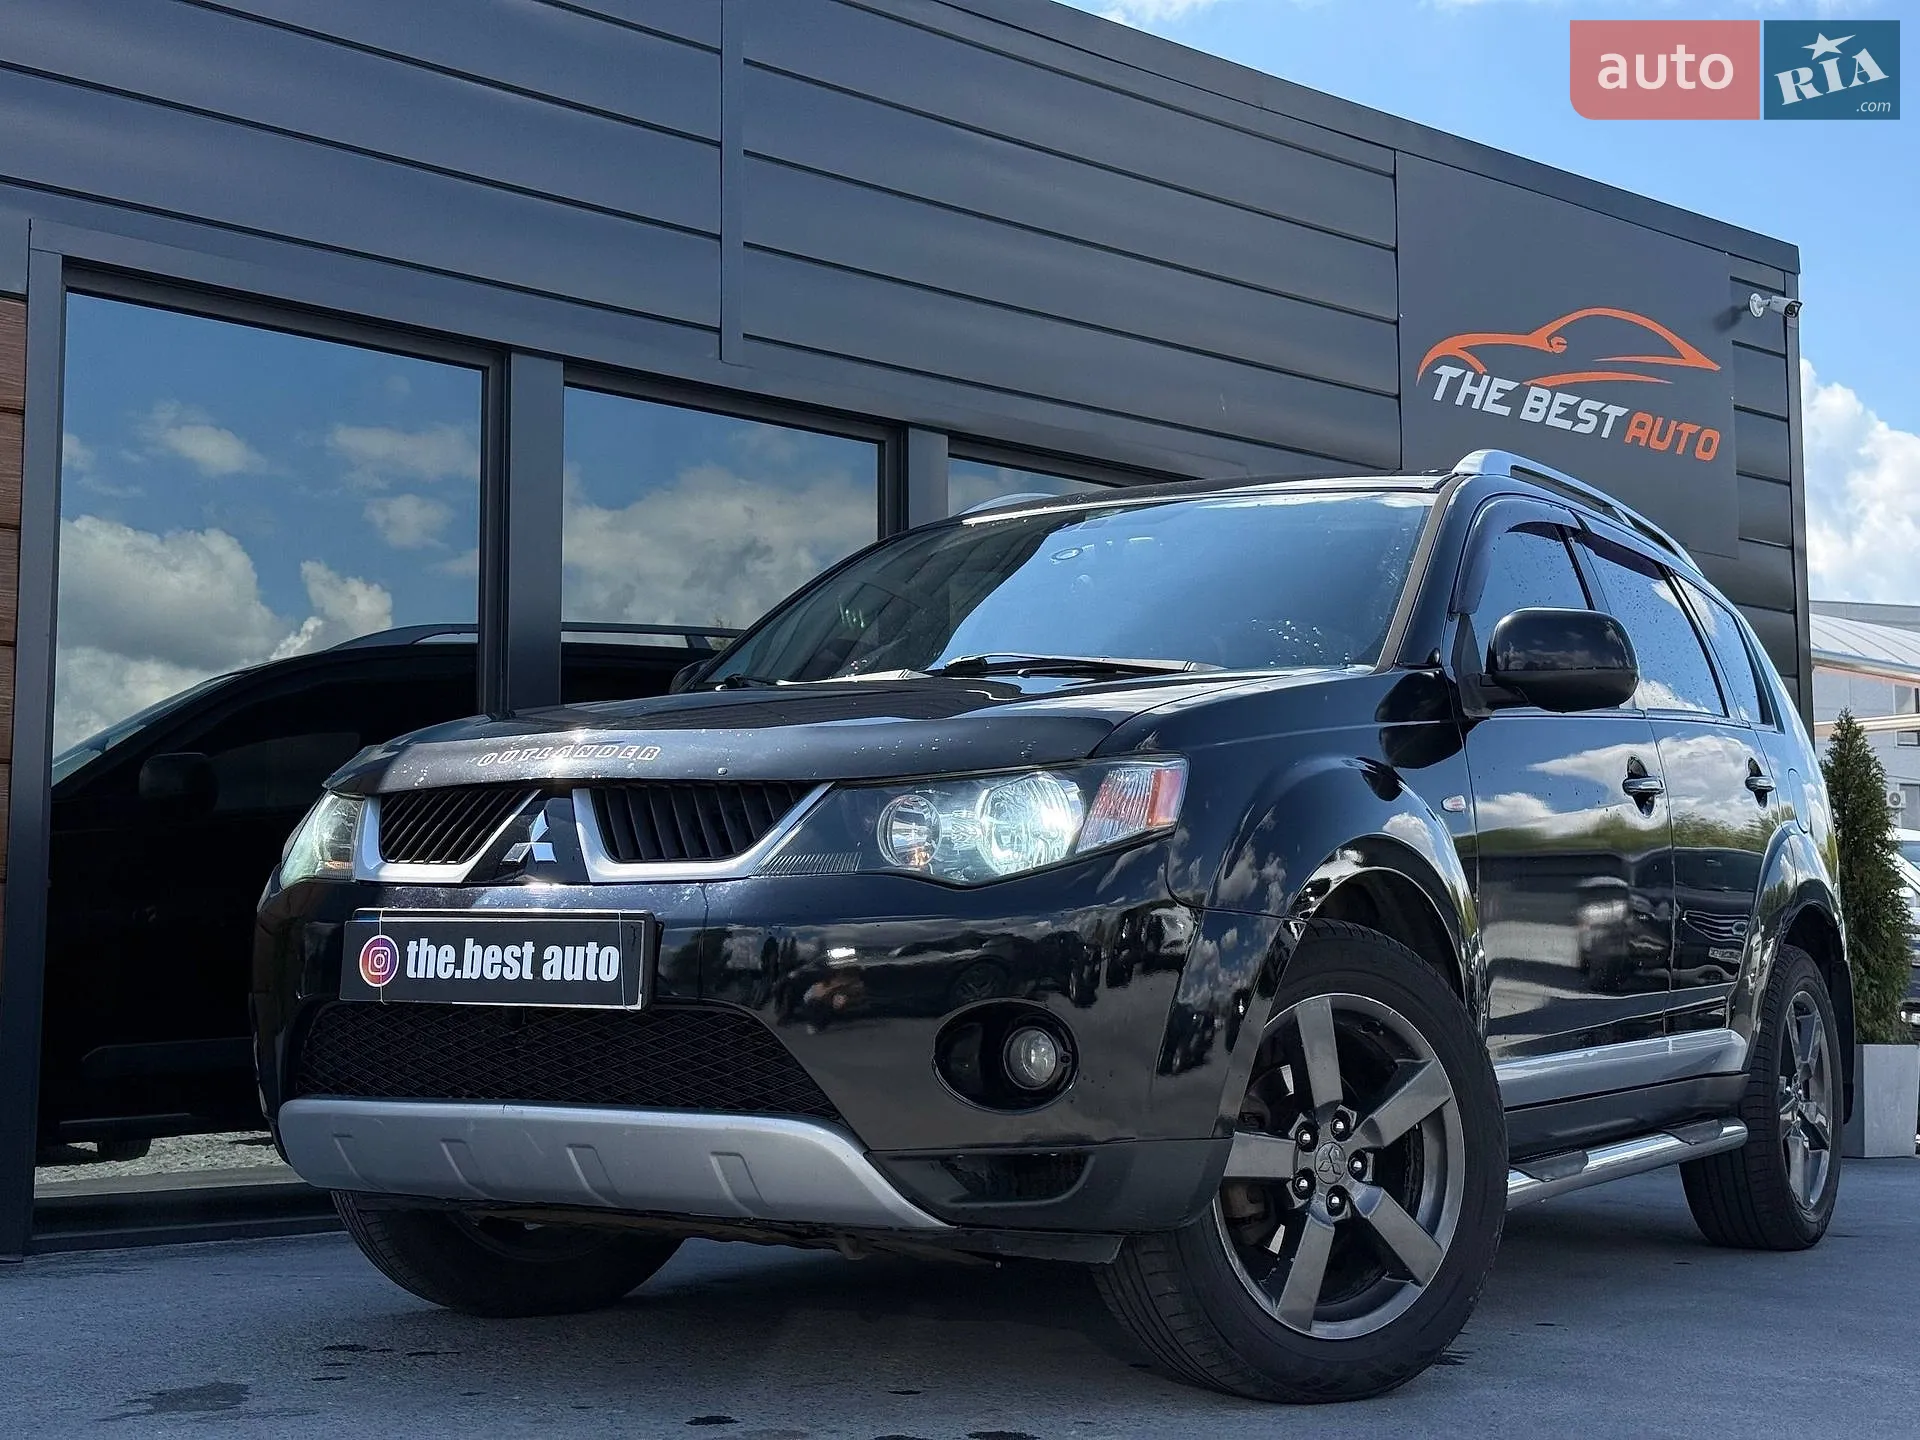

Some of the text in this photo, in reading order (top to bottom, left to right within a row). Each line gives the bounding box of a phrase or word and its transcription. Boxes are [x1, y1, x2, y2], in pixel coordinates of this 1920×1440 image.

[1432, 364, 1721, 462] THE BEST AUTO
[477, 744, 661, 766] OUTLANDER
[406, 937, 620, 982] the.best auto
